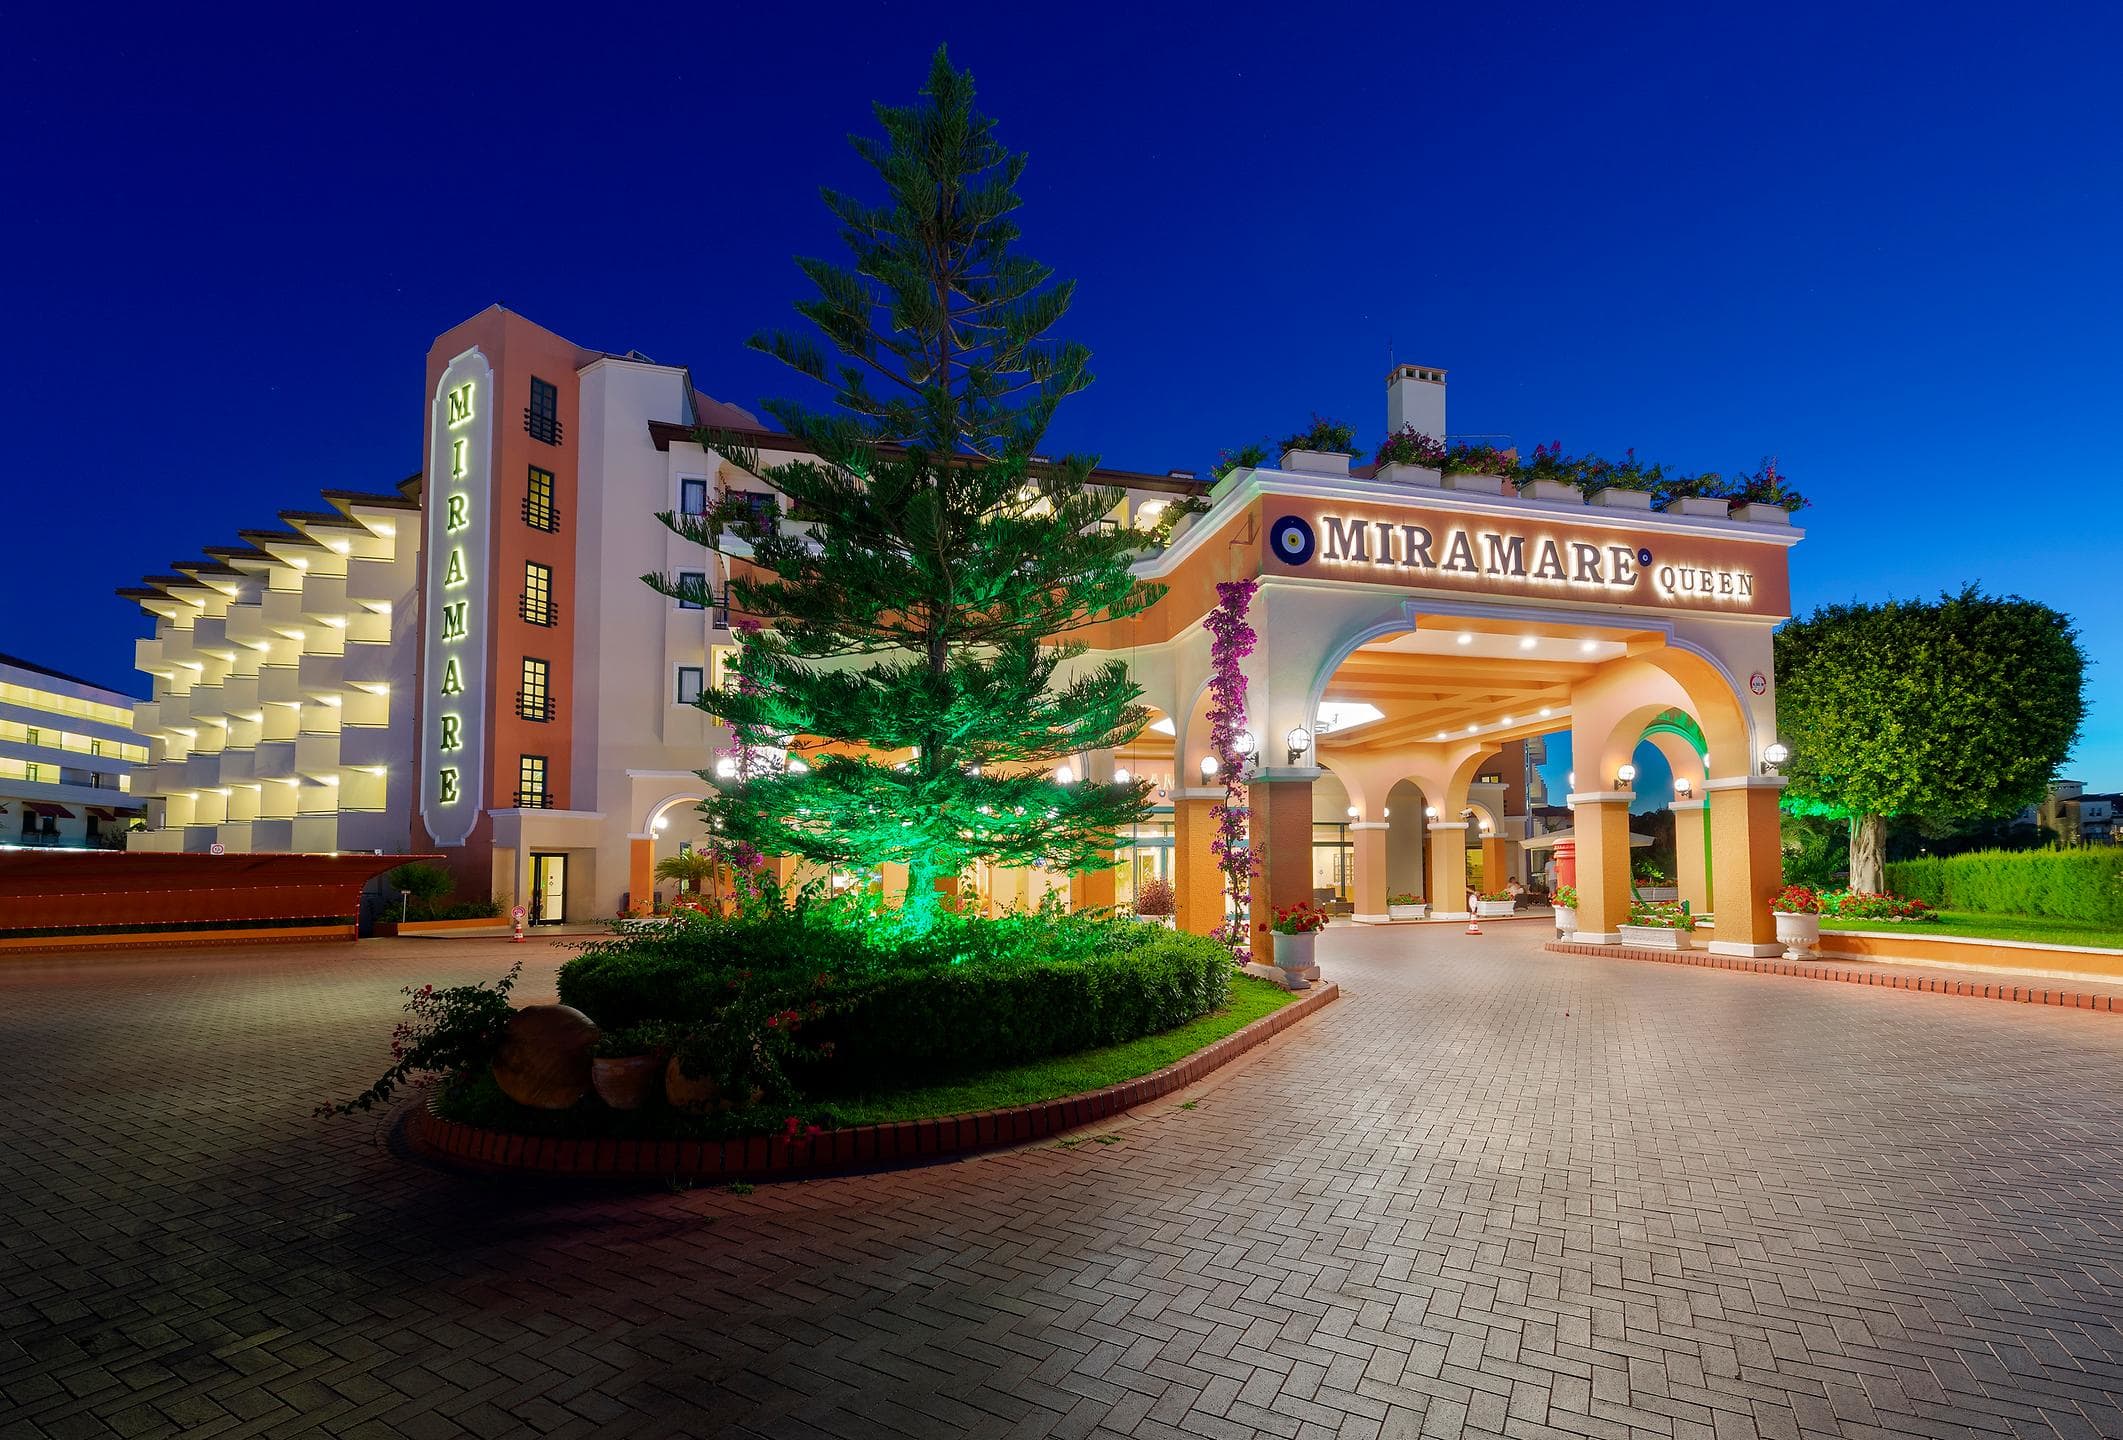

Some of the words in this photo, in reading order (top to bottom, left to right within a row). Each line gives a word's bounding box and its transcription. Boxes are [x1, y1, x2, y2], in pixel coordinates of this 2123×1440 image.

[439, 383, 473, 803] MIRAMARE
[1322, 516, 1639, 586] MIRAMARE
[1660, 566, 1753, 596] QUEEN
